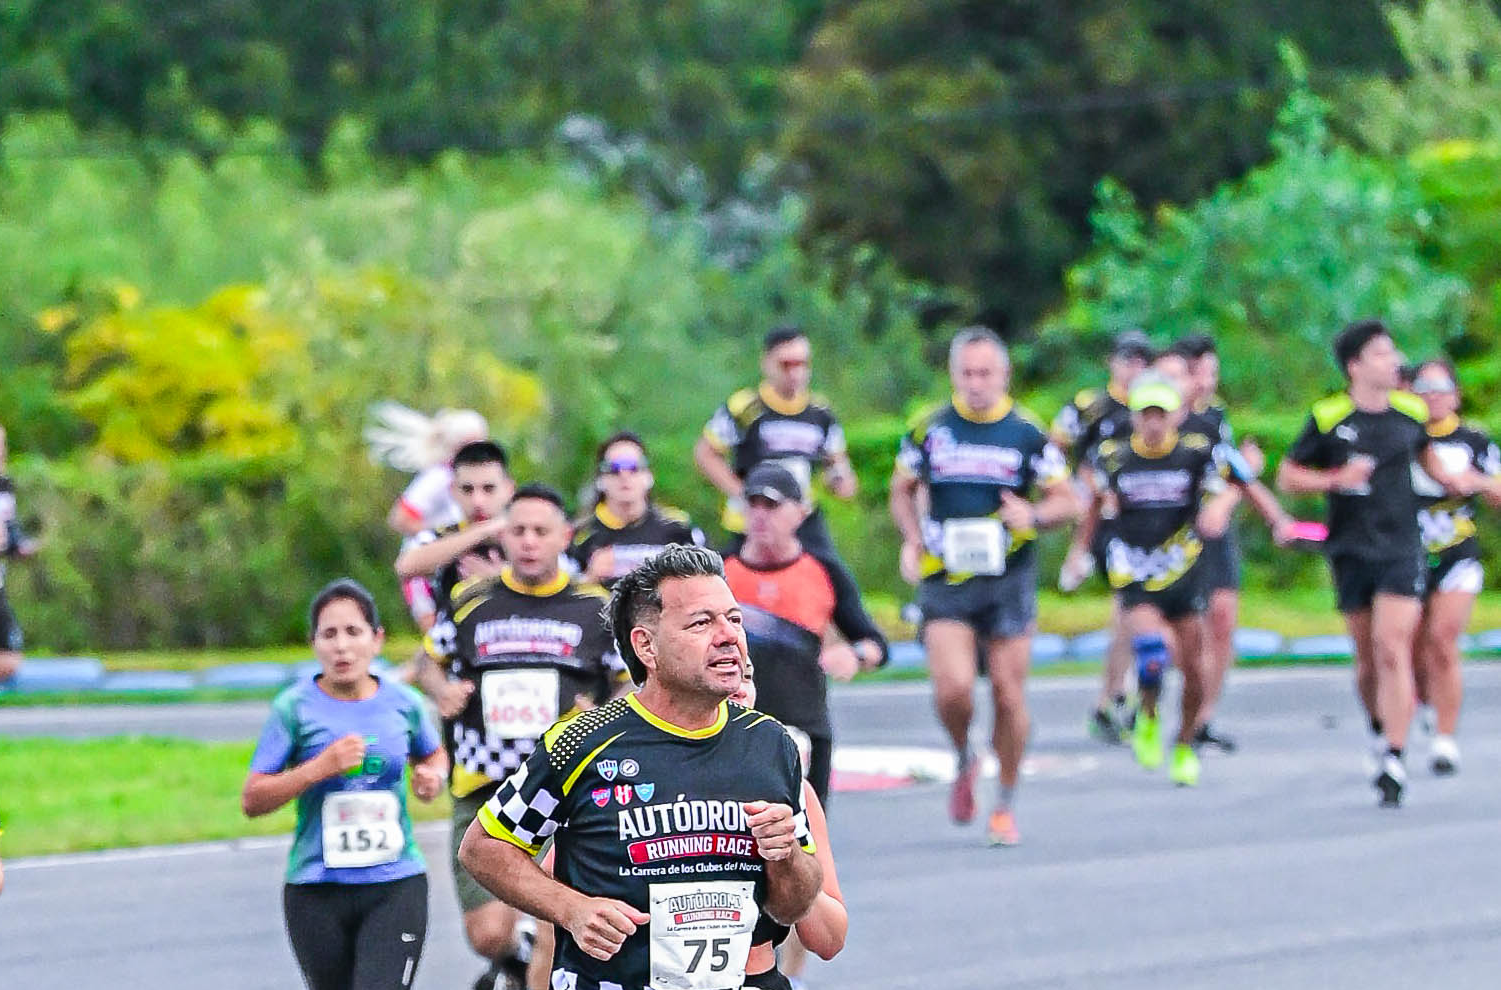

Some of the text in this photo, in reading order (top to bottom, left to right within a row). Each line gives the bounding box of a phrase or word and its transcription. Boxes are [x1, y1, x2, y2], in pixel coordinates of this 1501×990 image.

[617, 794, 749, 841] AUTÓDRO
[339, 829, 389, 853] 152
[646, 836, 754, 860] RUNNING RACE
[619, 866, 630, 877] La
[631, 864, 667, 876] Carrera
[668, 864, 680, 875] de
[681, 863, 695, 874] los
[696, 861, 723, 873] Clubes
[724, 861, 738, 872] del
[668, 888, 743, 914] AUTÓDROMO
[683, 938, 731, 974] 75
